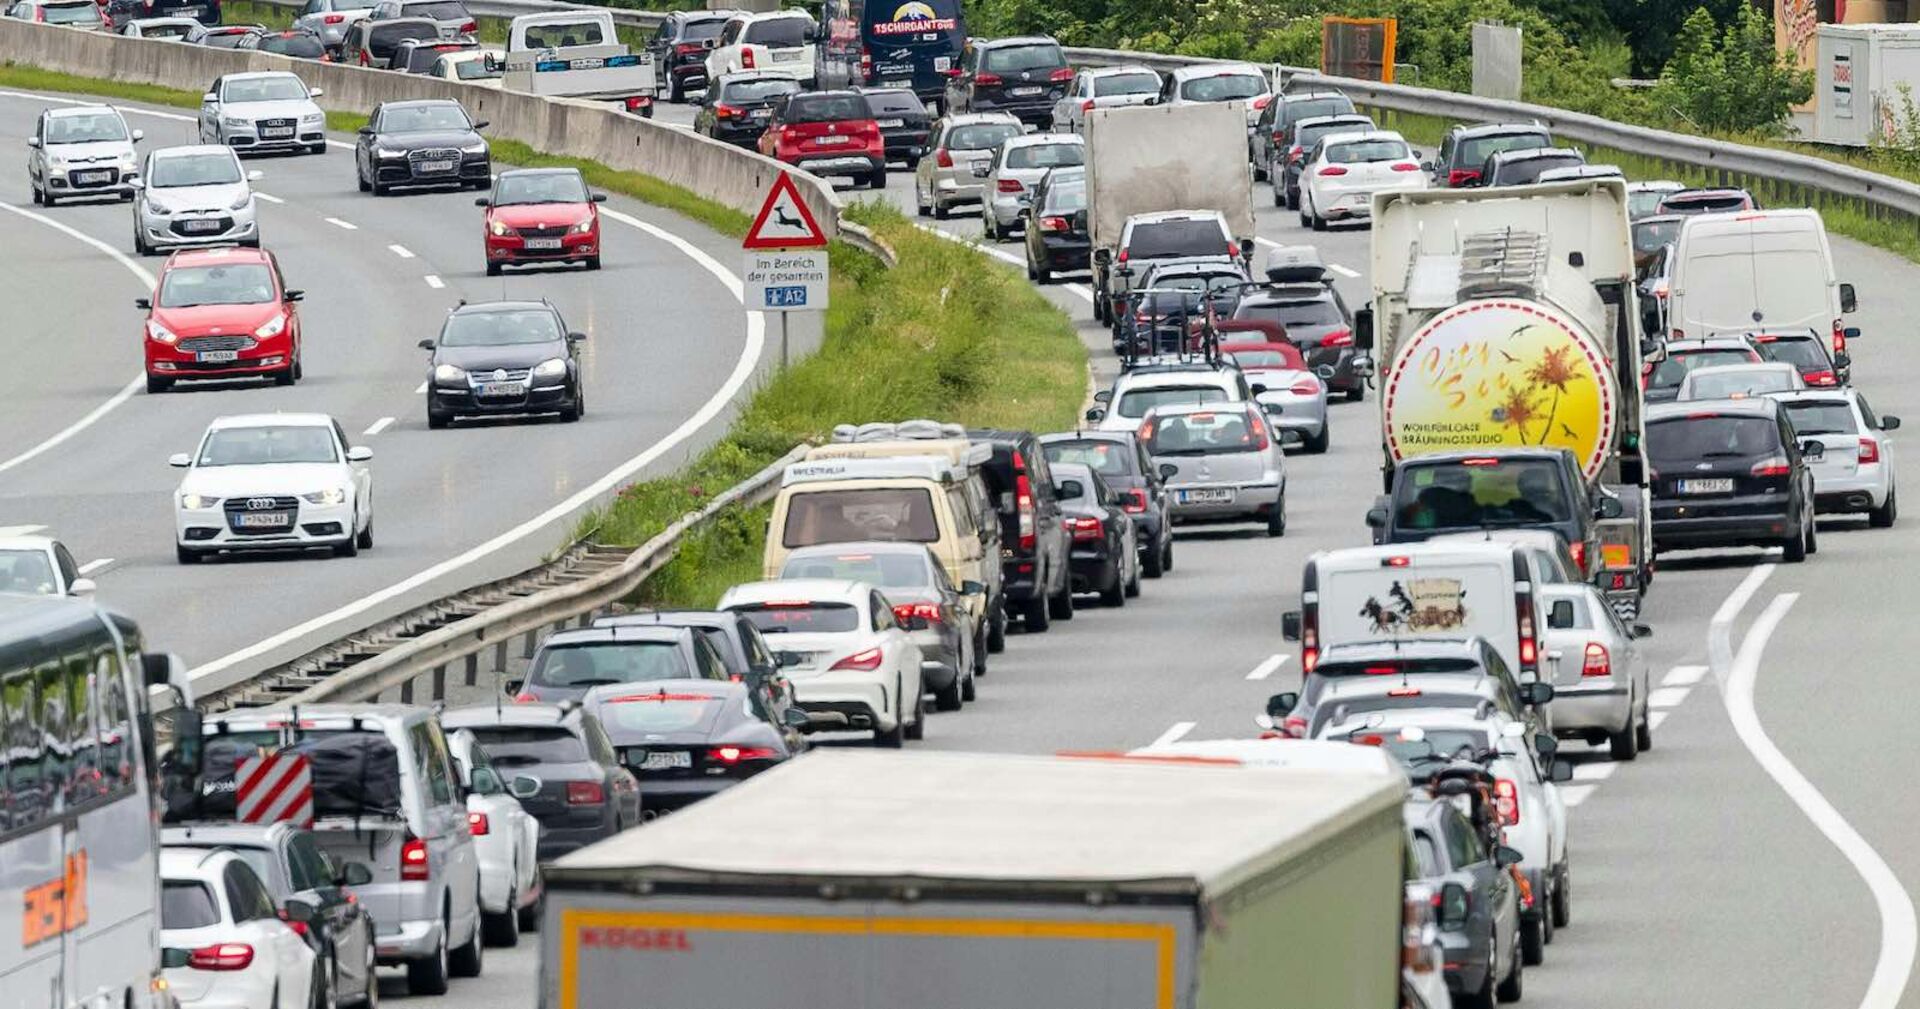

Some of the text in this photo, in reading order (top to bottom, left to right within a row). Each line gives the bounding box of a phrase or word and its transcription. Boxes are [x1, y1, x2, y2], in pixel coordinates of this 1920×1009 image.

[757, 257, 815, 269] Im Bereich
[748, 271, 823, 284] der gesamten
[785, 289, 805, 303] A12
